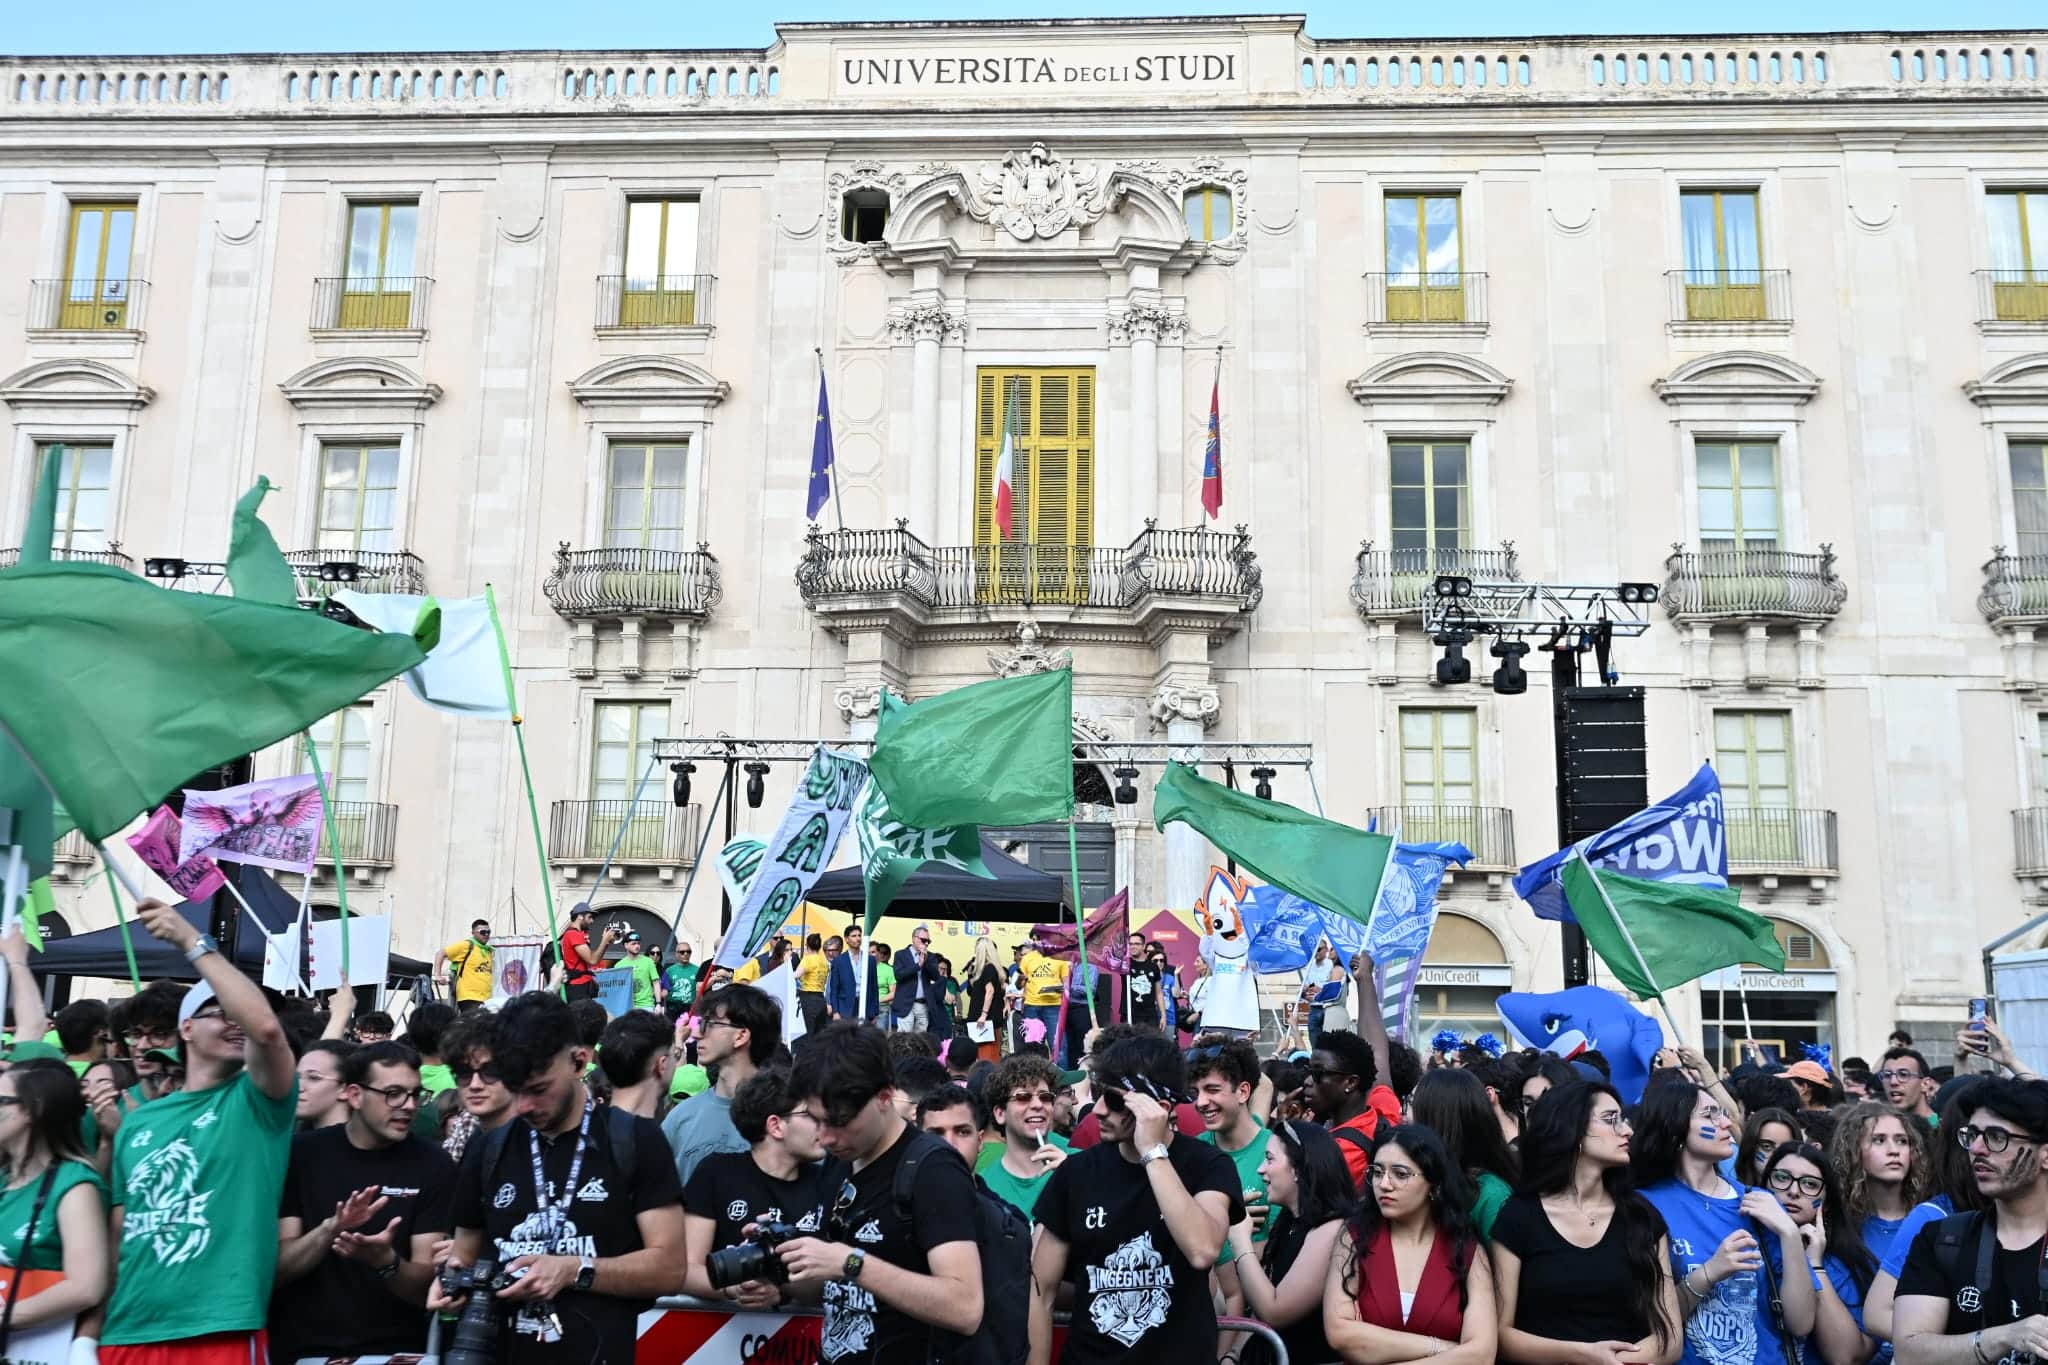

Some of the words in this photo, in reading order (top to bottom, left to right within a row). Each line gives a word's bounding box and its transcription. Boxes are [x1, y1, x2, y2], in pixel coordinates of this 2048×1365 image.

[844, 57, 1057, 85] UNIVERSITÀ
[1063, 65, 1129, 83] DEGLI
[1135, 53, 1236, 82] STUDI
[1425, 969, 1481, 983] UniCredit
[1749, 975, 1805, 989] UniCredit
